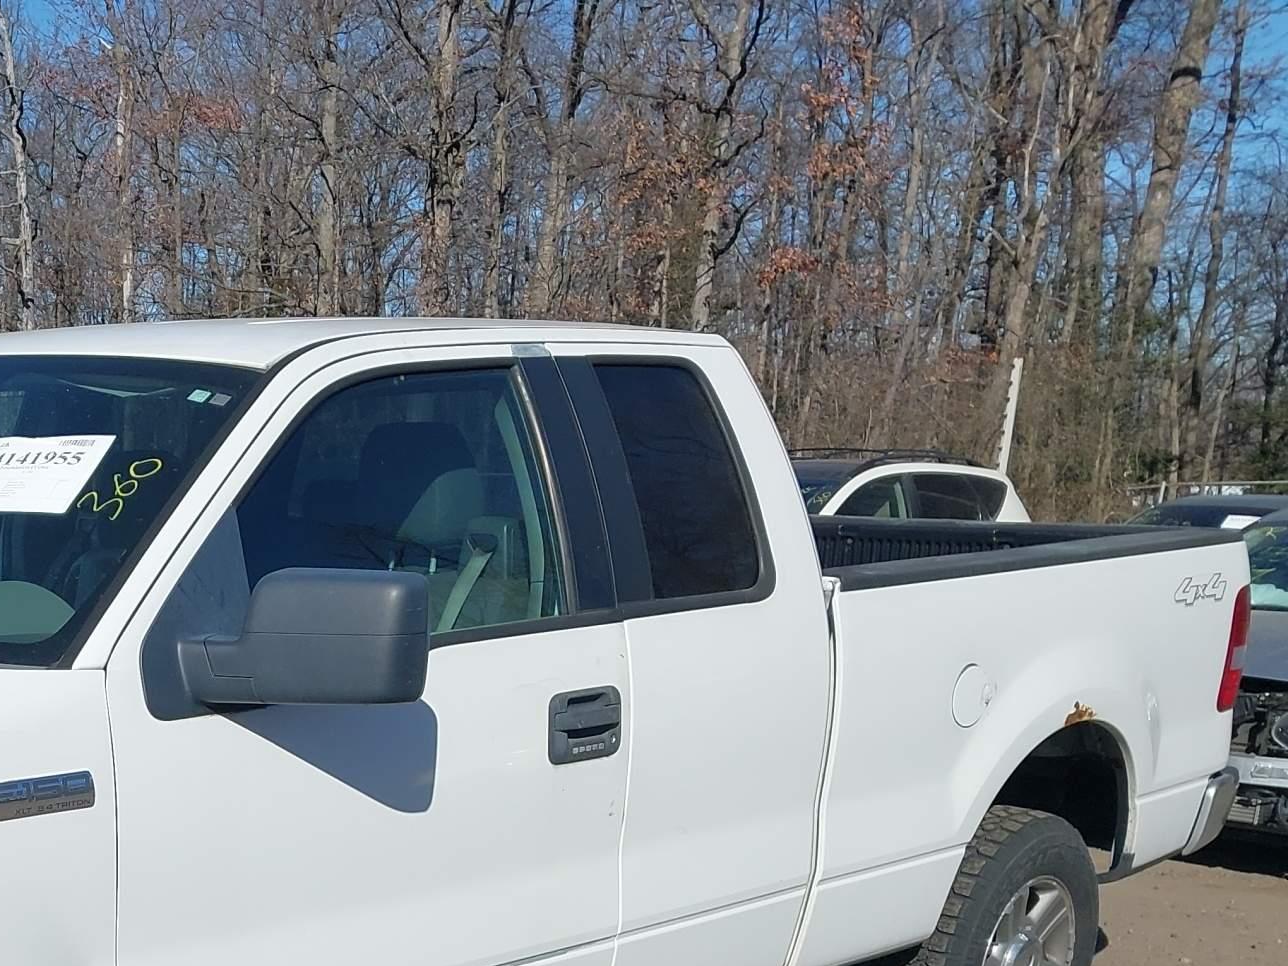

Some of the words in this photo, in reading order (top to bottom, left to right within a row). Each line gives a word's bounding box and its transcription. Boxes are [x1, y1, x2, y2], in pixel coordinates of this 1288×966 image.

[76, 457, 162, 520] 360
[1174, 572, 1227, 606] 4x4
[56, 799, 92, 810] TRITON
